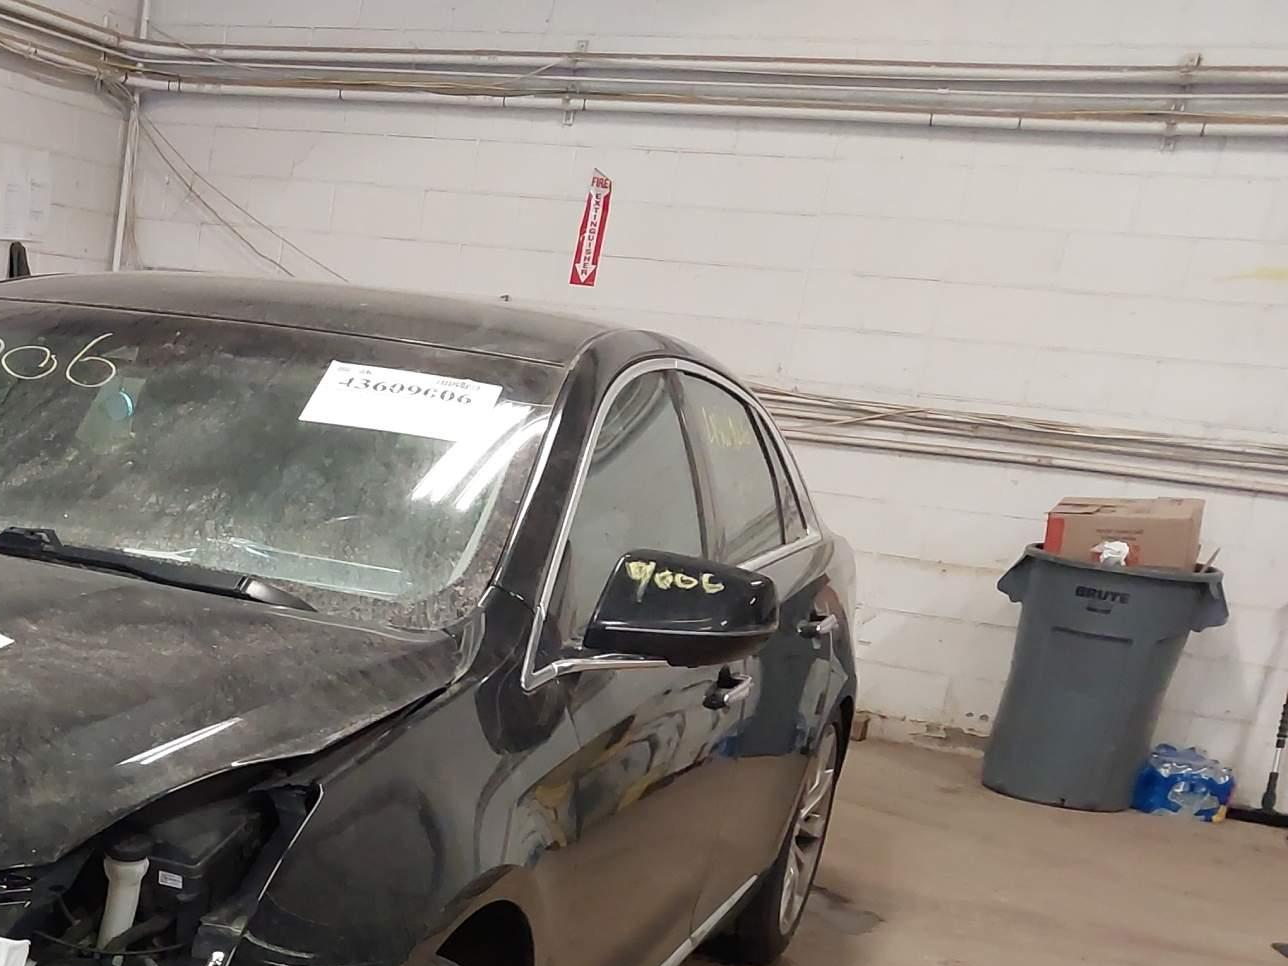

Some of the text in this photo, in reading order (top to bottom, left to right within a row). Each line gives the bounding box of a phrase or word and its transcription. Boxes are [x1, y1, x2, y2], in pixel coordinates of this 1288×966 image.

[591, 176, 609, 189] FIRE
[580, 193, 601, 276] EXTINGUISHER
[1075, 585, 1130, 604] BRUTE
